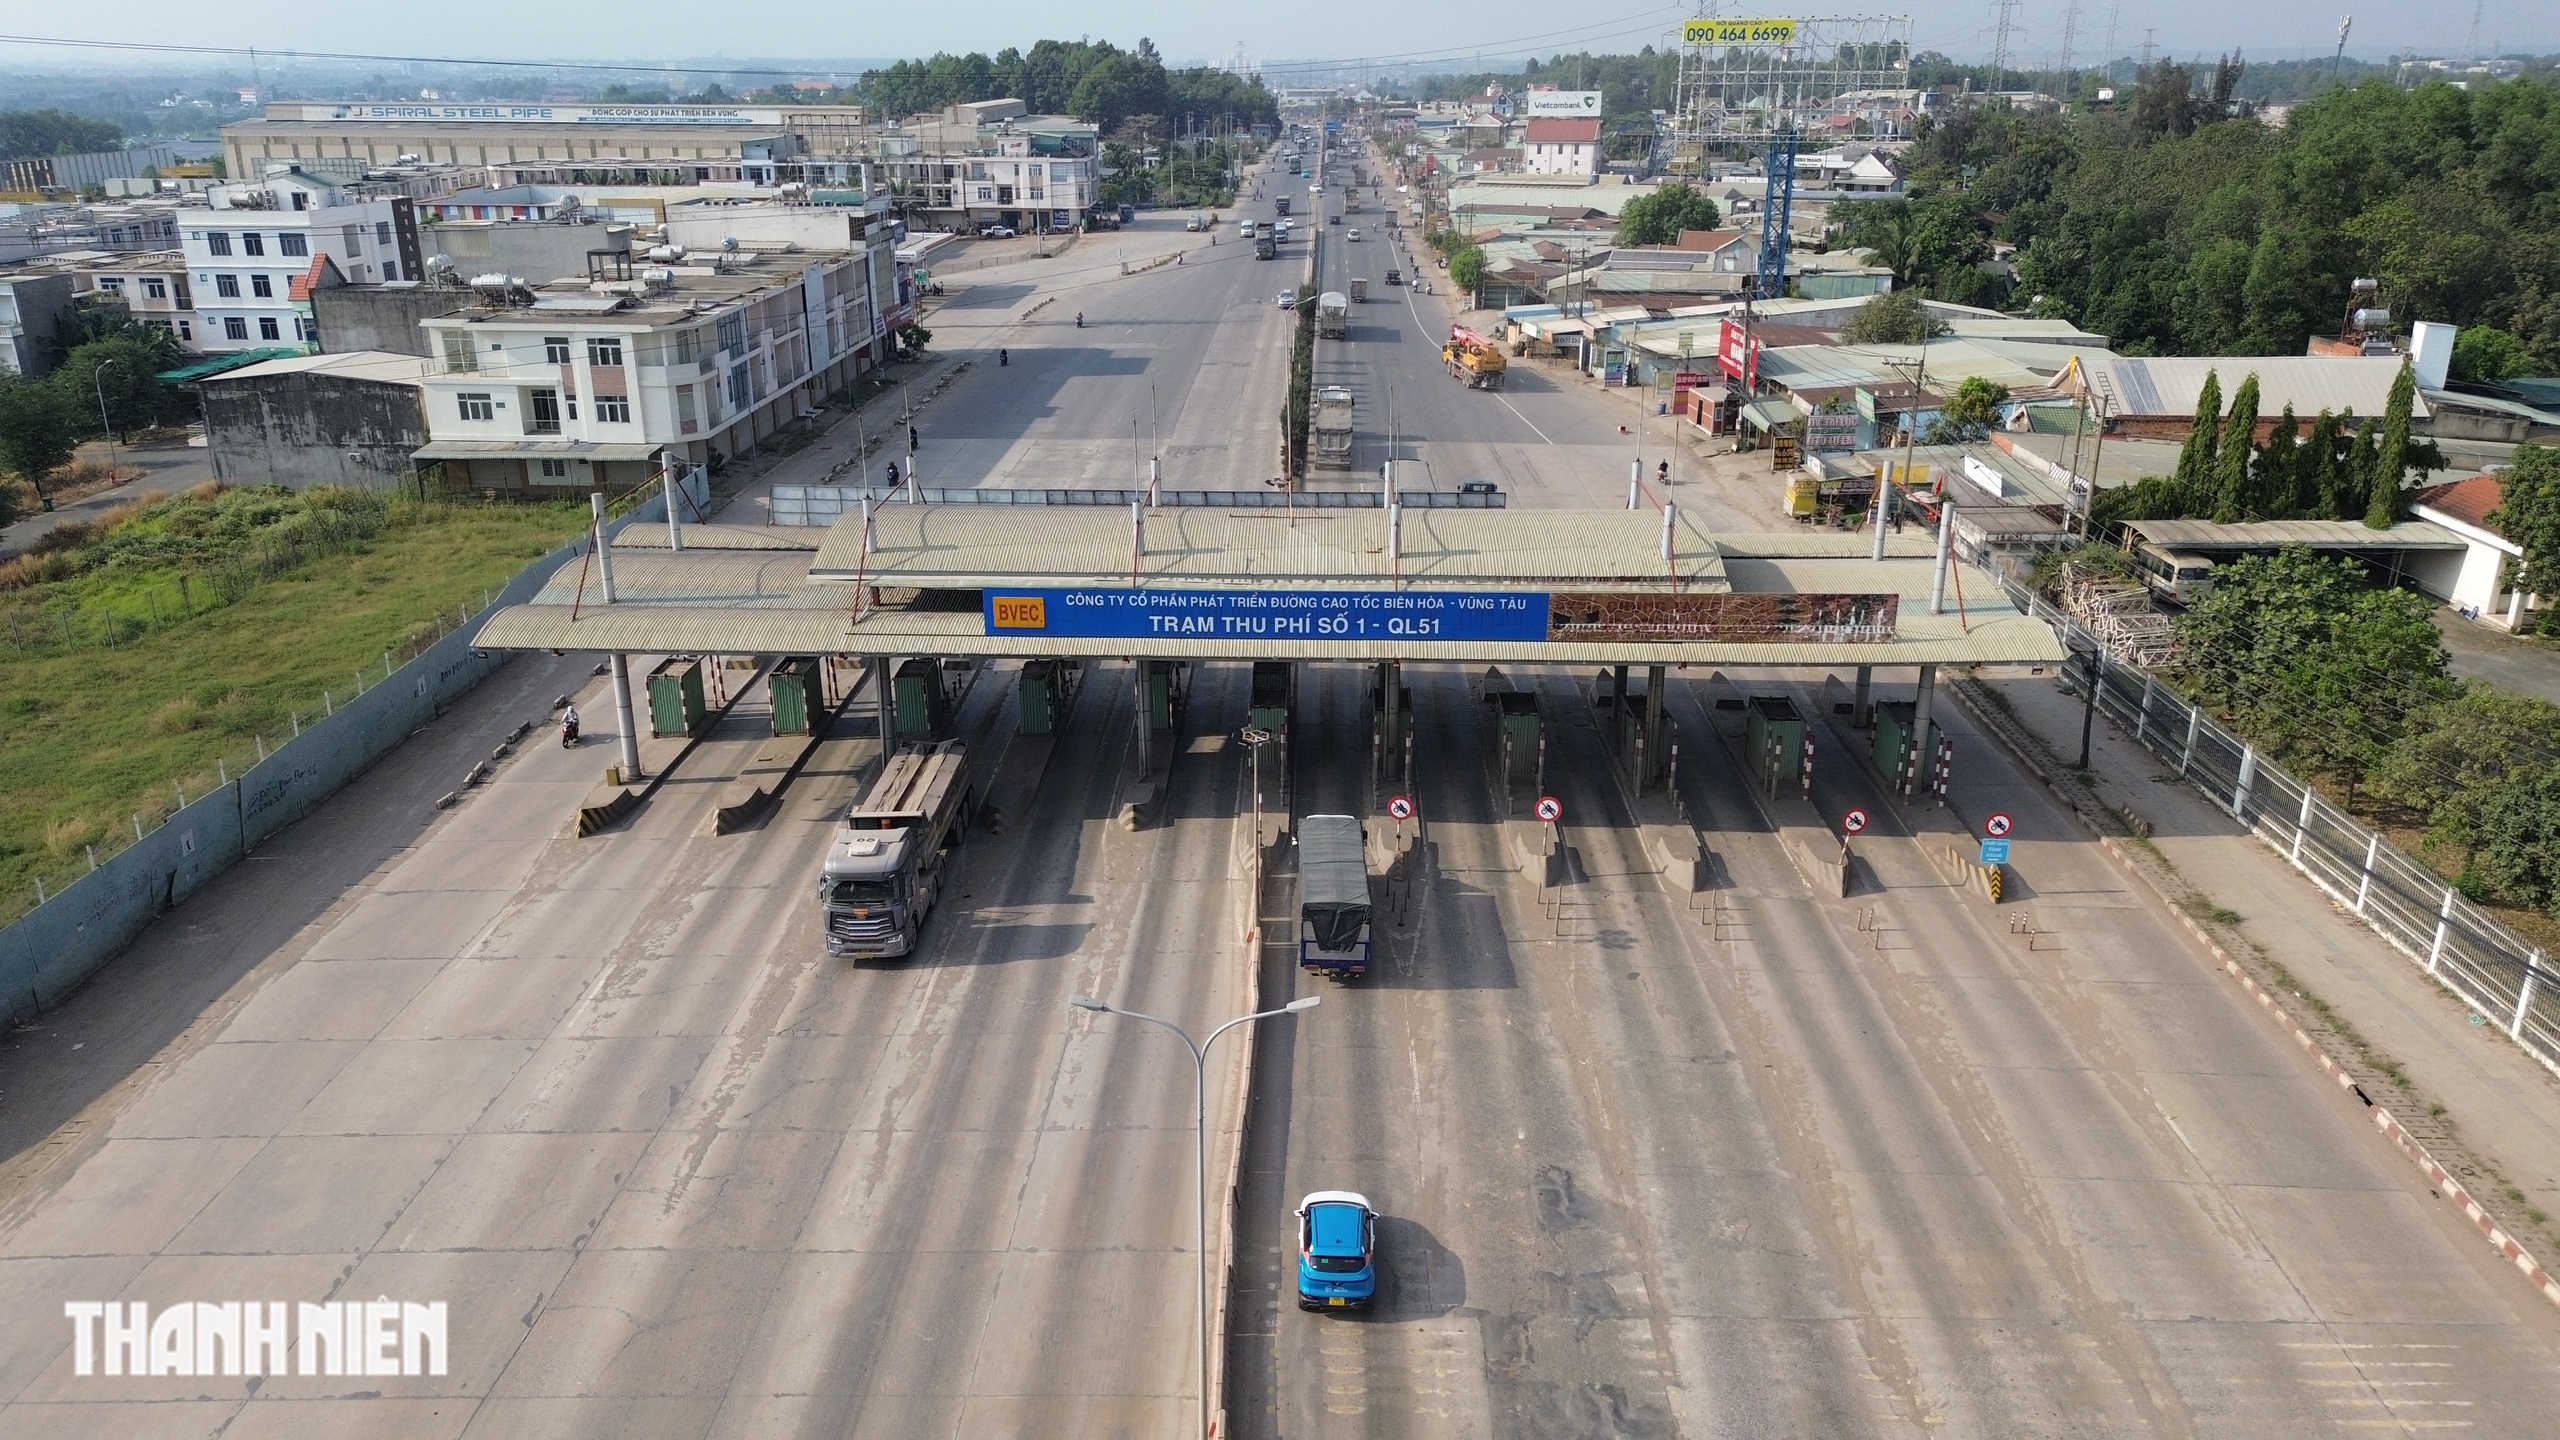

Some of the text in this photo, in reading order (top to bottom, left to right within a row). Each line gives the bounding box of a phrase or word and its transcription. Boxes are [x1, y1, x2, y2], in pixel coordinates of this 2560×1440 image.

[1687, 27, 1790, 41] 090 464 6699
[443, 107, 506, 118] STEEL
[511, 108, 552, 118] PIPE
[1534, 101, 1581, 109] Vietcombank
[1066, 591, 1104, 606] CÔNG
[1108, 595, 1125, 606] TY
[1129, 590, 1147, 607] CỔ
[1151, 592, 1187, 607] PHẦN
[1190, 593, 1224, 607] PHÁT
[1229, 592, 1267, 608] TRIỂN
[1271, 595, 1317, 608] ĐƯỜNG
[1321, 598, 1349, 609] CAO
[1353, 594, 1380, 609] TỐC
[1384, 594, 1414, 609] BIÊN
[1417, 595, 1444, 609] HÒA
[1458, 596, 1494, 610] VŨNG
[1500, 596, 1526, 610] TÀU
[1000, 604, 1039, 622] BVEC
[1150, 616, 1214, 634] TRẠM
[1222, 616, 1266, 633] THU
[1274, 613, 1310, 633] PHÍ
[1318, 612, 1349, 634] SỐ
[1357, 618, 1365, 634] 1
[1388, 618, 1440, 635] QL51
